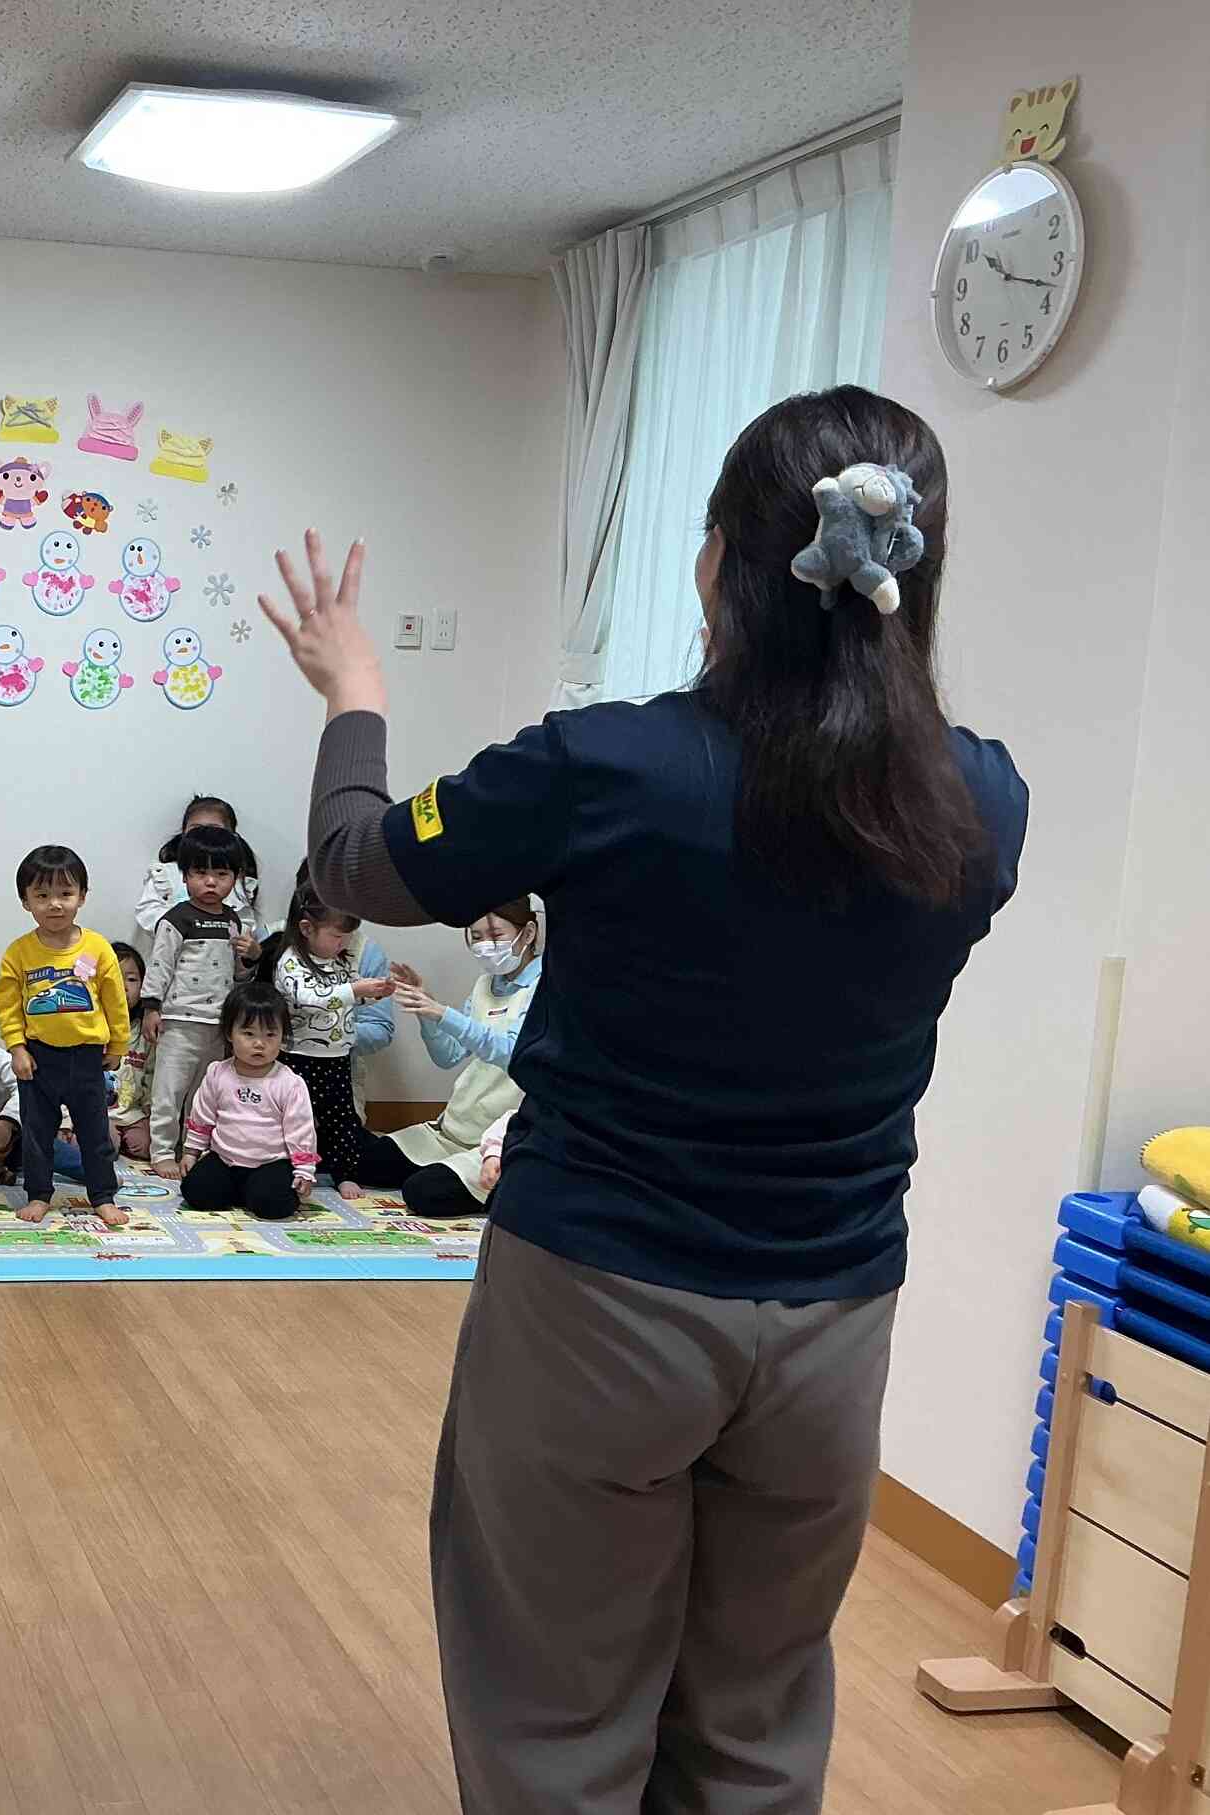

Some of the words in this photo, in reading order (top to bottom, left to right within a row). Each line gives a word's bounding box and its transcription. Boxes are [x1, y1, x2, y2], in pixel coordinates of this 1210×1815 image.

[1048, 214, 1061, 241] 2
[966, 239, 980, 264] 10
[1050, 251, 1064, 277] 3
[956, 278, 968, 301] 9
[1039, 290, 1052, 315] 4
[960, 312, 971, 336] 8
[975, 336, 986, 359] 7
[1022, 325, 1033, 349] 5
[997, 339, 1008, 363] 6
